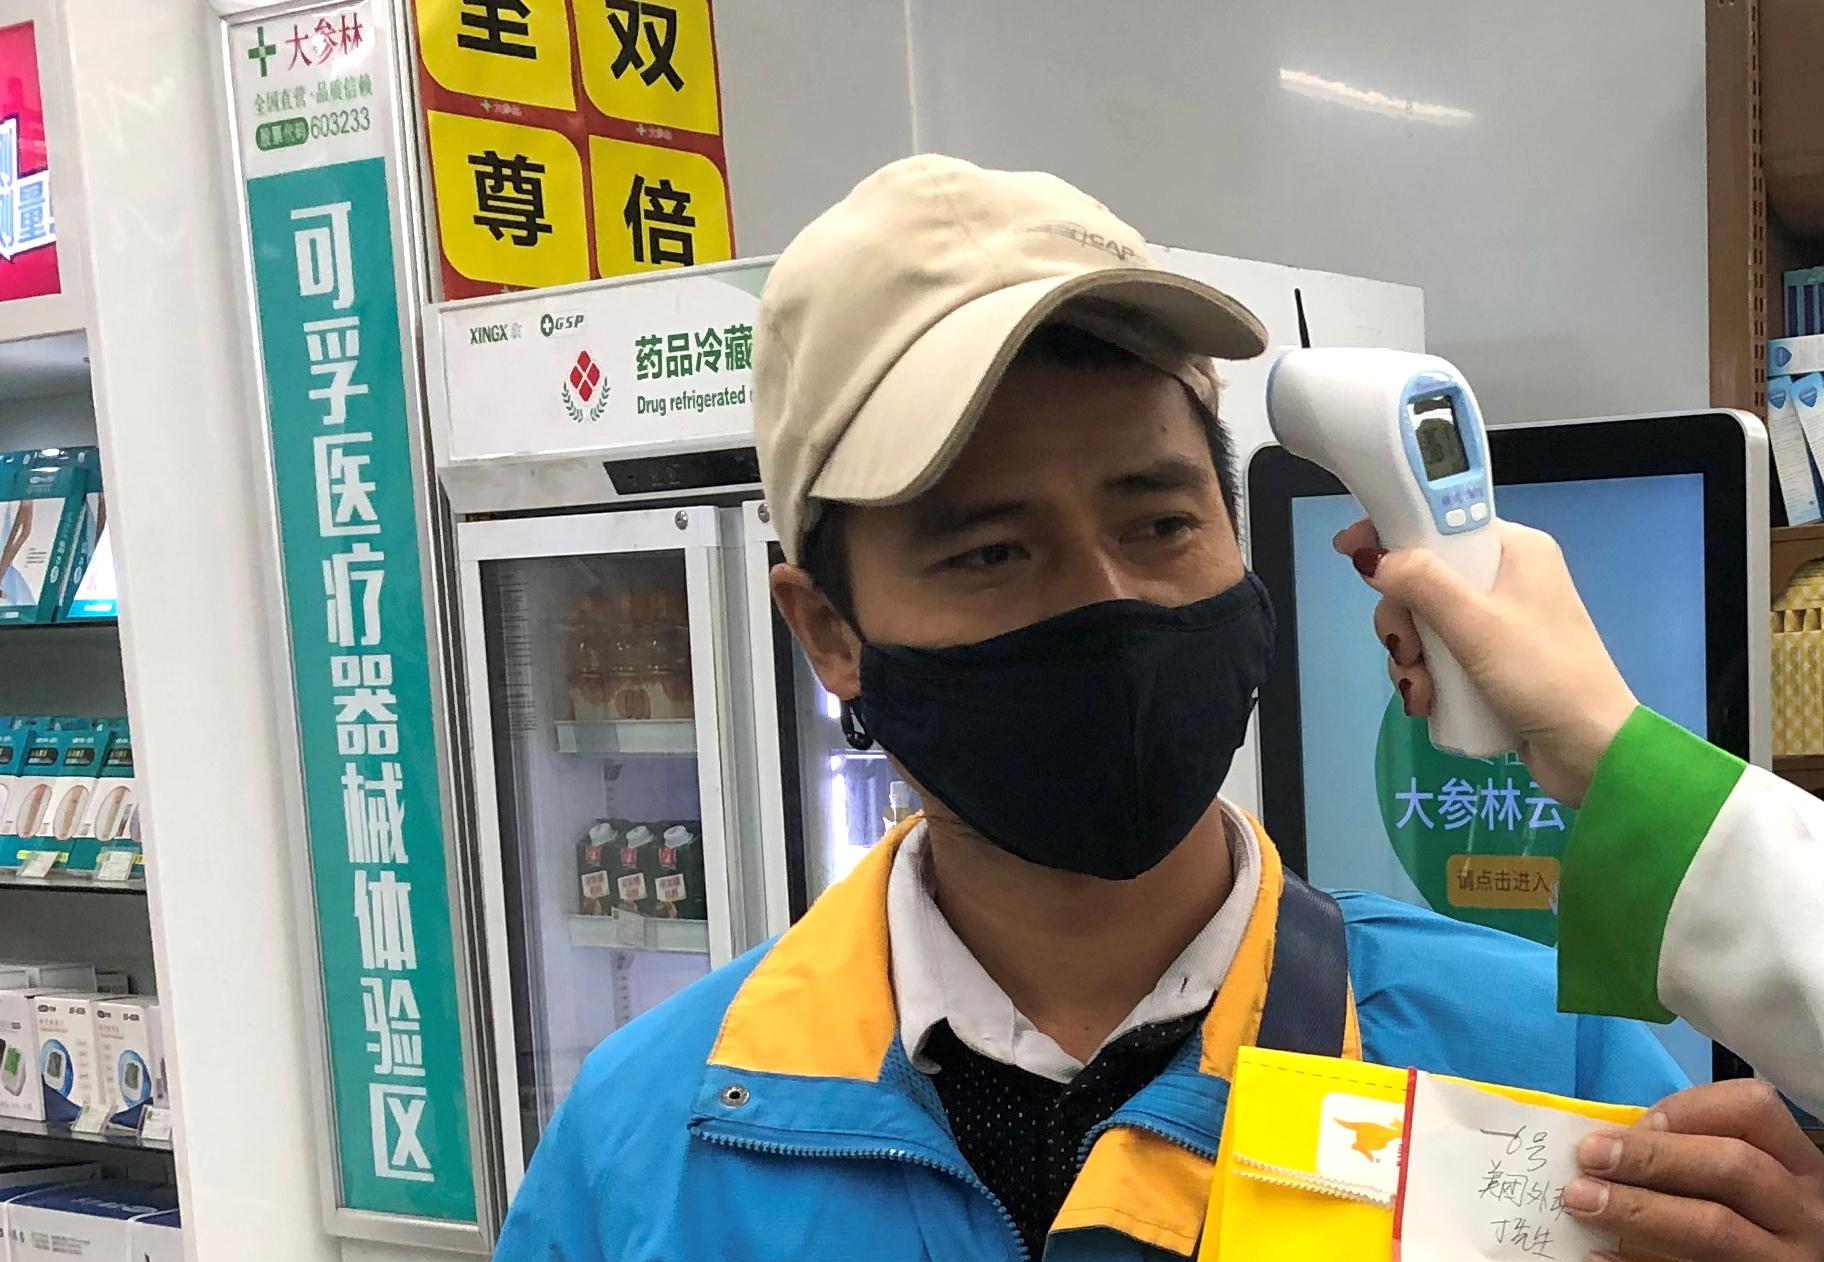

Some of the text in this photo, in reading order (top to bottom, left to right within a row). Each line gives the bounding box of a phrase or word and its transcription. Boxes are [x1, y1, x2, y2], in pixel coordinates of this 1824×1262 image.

[285, 13, 364, 71] 大参林
[310, 106, 371, 139] 603233
[555, 314, 584, 330] GSP
[635, 324, 753, 381] 药品冷藏
[637, 384, 746, 416] Drug refrigerated
[290, 202, 435, 1182] 可孚医疗器械体验区
[1456, 868, 1551, 892] 请点击进入
